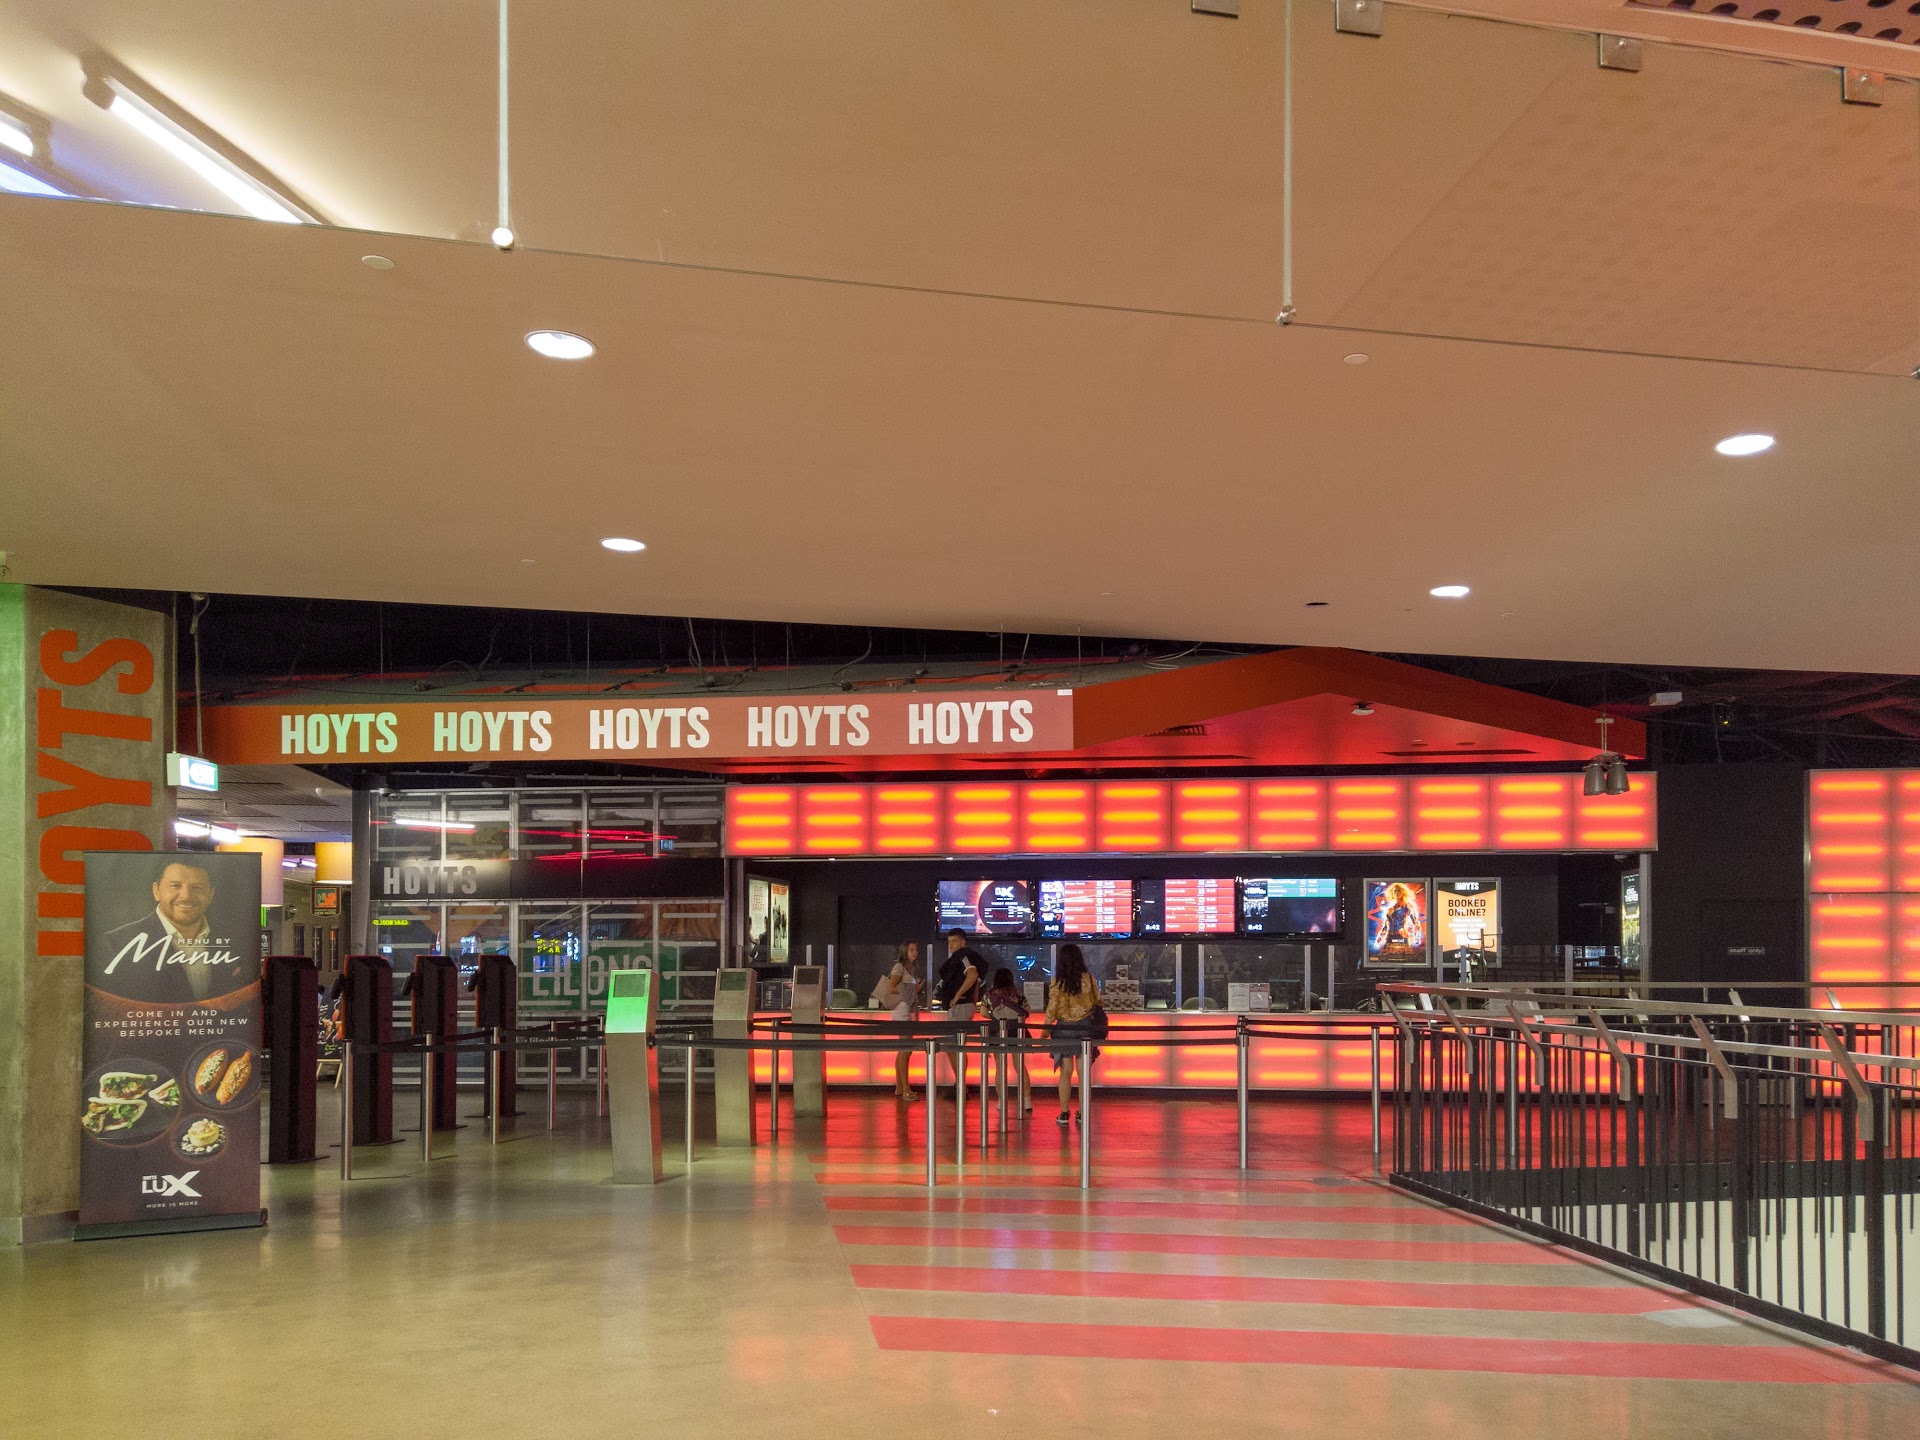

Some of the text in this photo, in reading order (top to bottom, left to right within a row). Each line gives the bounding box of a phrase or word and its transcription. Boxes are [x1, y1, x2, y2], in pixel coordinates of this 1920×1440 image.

[281, 699, 1034, 755] HOYTS HOYTS HOYTS HOYTS HOYTS
[383, 866, 477, 895] HOYTS
[1455, 882, 1480, 890] HOYTS
[1448, 899, 1486, 908] BOOKED
[1448, 908, 1487, 917] ONLINE?
[104, 932, 240, 975] Manu
[126, 1010, 164, 1018] COME
[191, 1009, 218, 1017] AND
[94, 1019, 180, 1028] EXPERIENCE
[220, 1018, 248, 1026] NEW
[119, 1028, 182, 1037] BESPOKE
[141, 1170, 203, 1197] LUX
